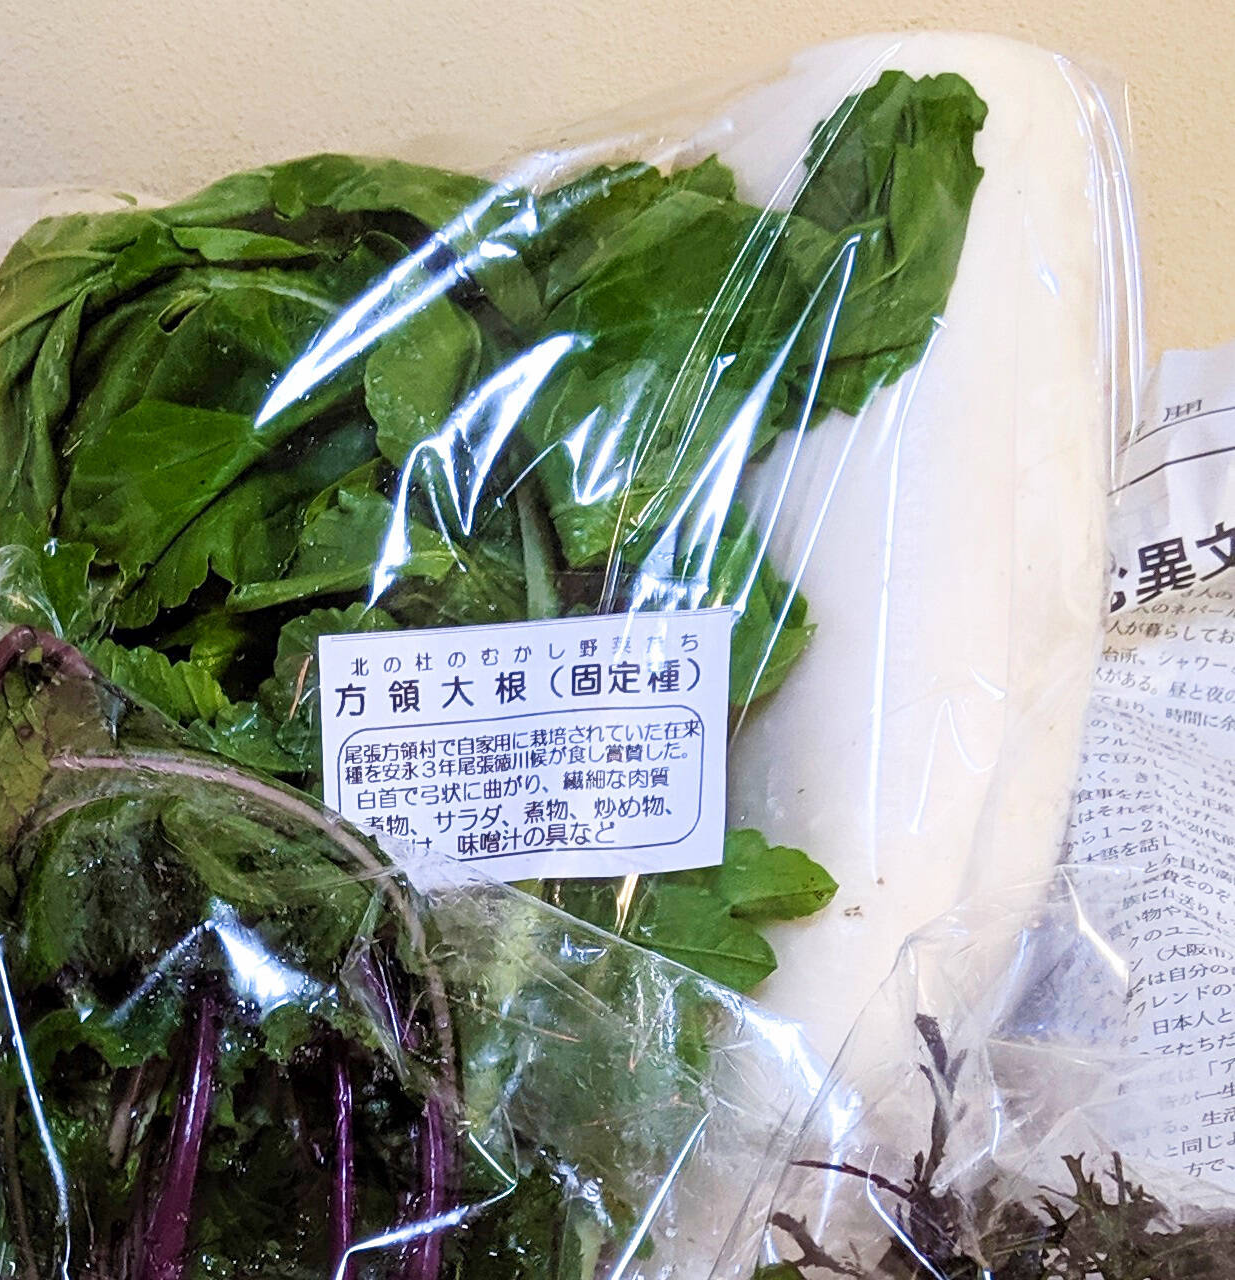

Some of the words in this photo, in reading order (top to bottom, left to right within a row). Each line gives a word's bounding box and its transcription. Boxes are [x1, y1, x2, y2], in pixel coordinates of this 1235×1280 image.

[458, 821, 615, 856] 味噌汁の具など
